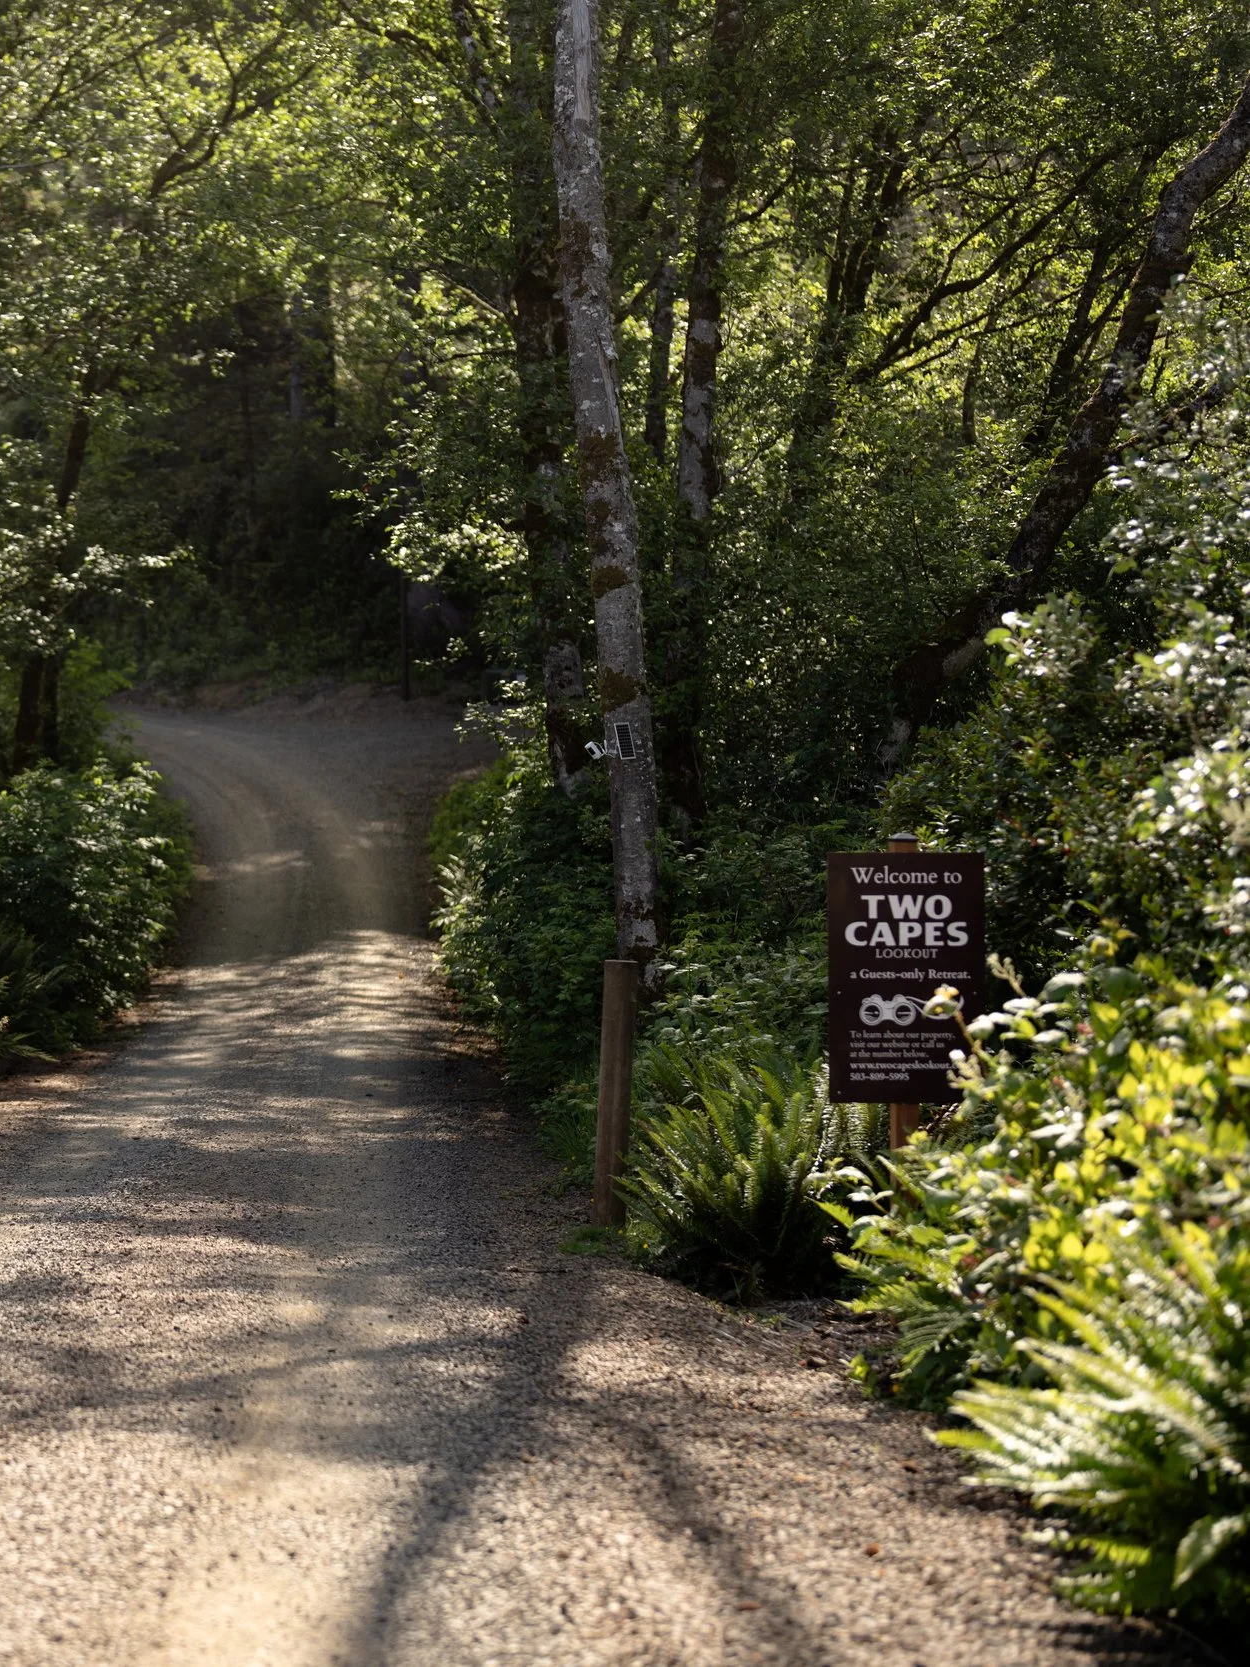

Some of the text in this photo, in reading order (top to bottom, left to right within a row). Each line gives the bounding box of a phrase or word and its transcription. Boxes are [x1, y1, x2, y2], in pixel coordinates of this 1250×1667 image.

[850, 865, 963, 884] Welcome to
[860, 894, 953, 920] TWO
[844, 921, 969, 947] CAPES
[875, 948, 939, 959] LOOKOUT
[850, 968, 972, 982] a Guests-only Retreat.
[850, 1030, 862, 1039] To
[862, 1029, 882, 1039] learn
[883, 1029, 905, 1039] about
[850, 1039, 866, 1048] visit
[881, 1039, 910, 1048] website
[921, 1039, 935, 1048] call
[858, 1049, 871, 1058] the
[872, 1049, 902, 1058] number
[902, 1049, 930, 1058] below.
[850, 1060, 958, 1072] www.twocapeslookout.c
